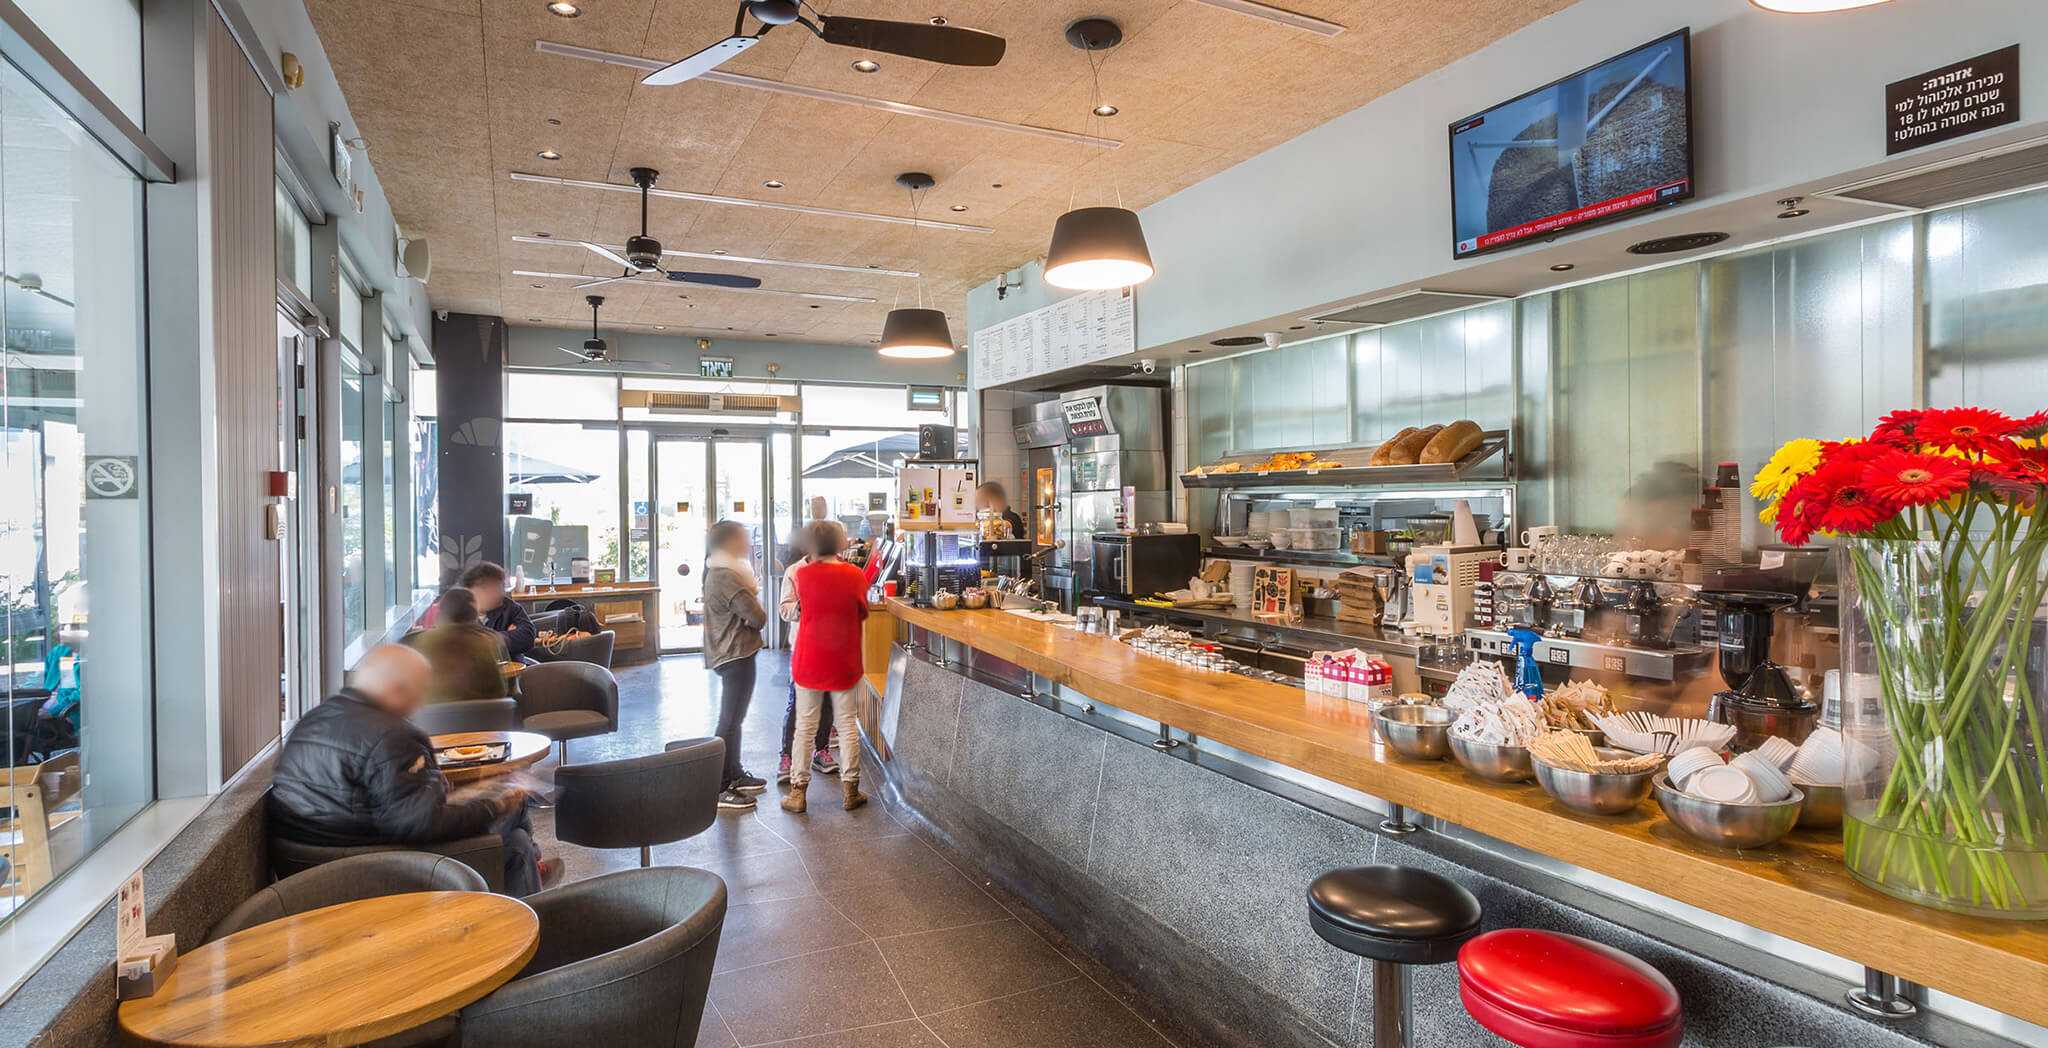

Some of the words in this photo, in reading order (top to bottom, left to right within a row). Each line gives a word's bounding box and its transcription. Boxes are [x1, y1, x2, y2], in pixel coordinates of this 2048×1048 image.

[1922, 67, 1973, 91] אזהרה:
[1966, 72, 2004, 93] מכירת
[1895, 98, 1914, 112] למי
[1917, 85, 1963, 107] אלכוהול
[1964, 88, 2000, 108] שטרם
[1917, 108, 1928, 121] לו
[1932, 100, 1960, 117] מלאו
[1981, 102, 2005, 117] הנה
[1900, 114, 1914, 126] 18
[1941, 109, 1978, 129] אסורה
[1895, 121, 1937, 141] בהחלט!
[701, 361, 732, 376] יציאה
